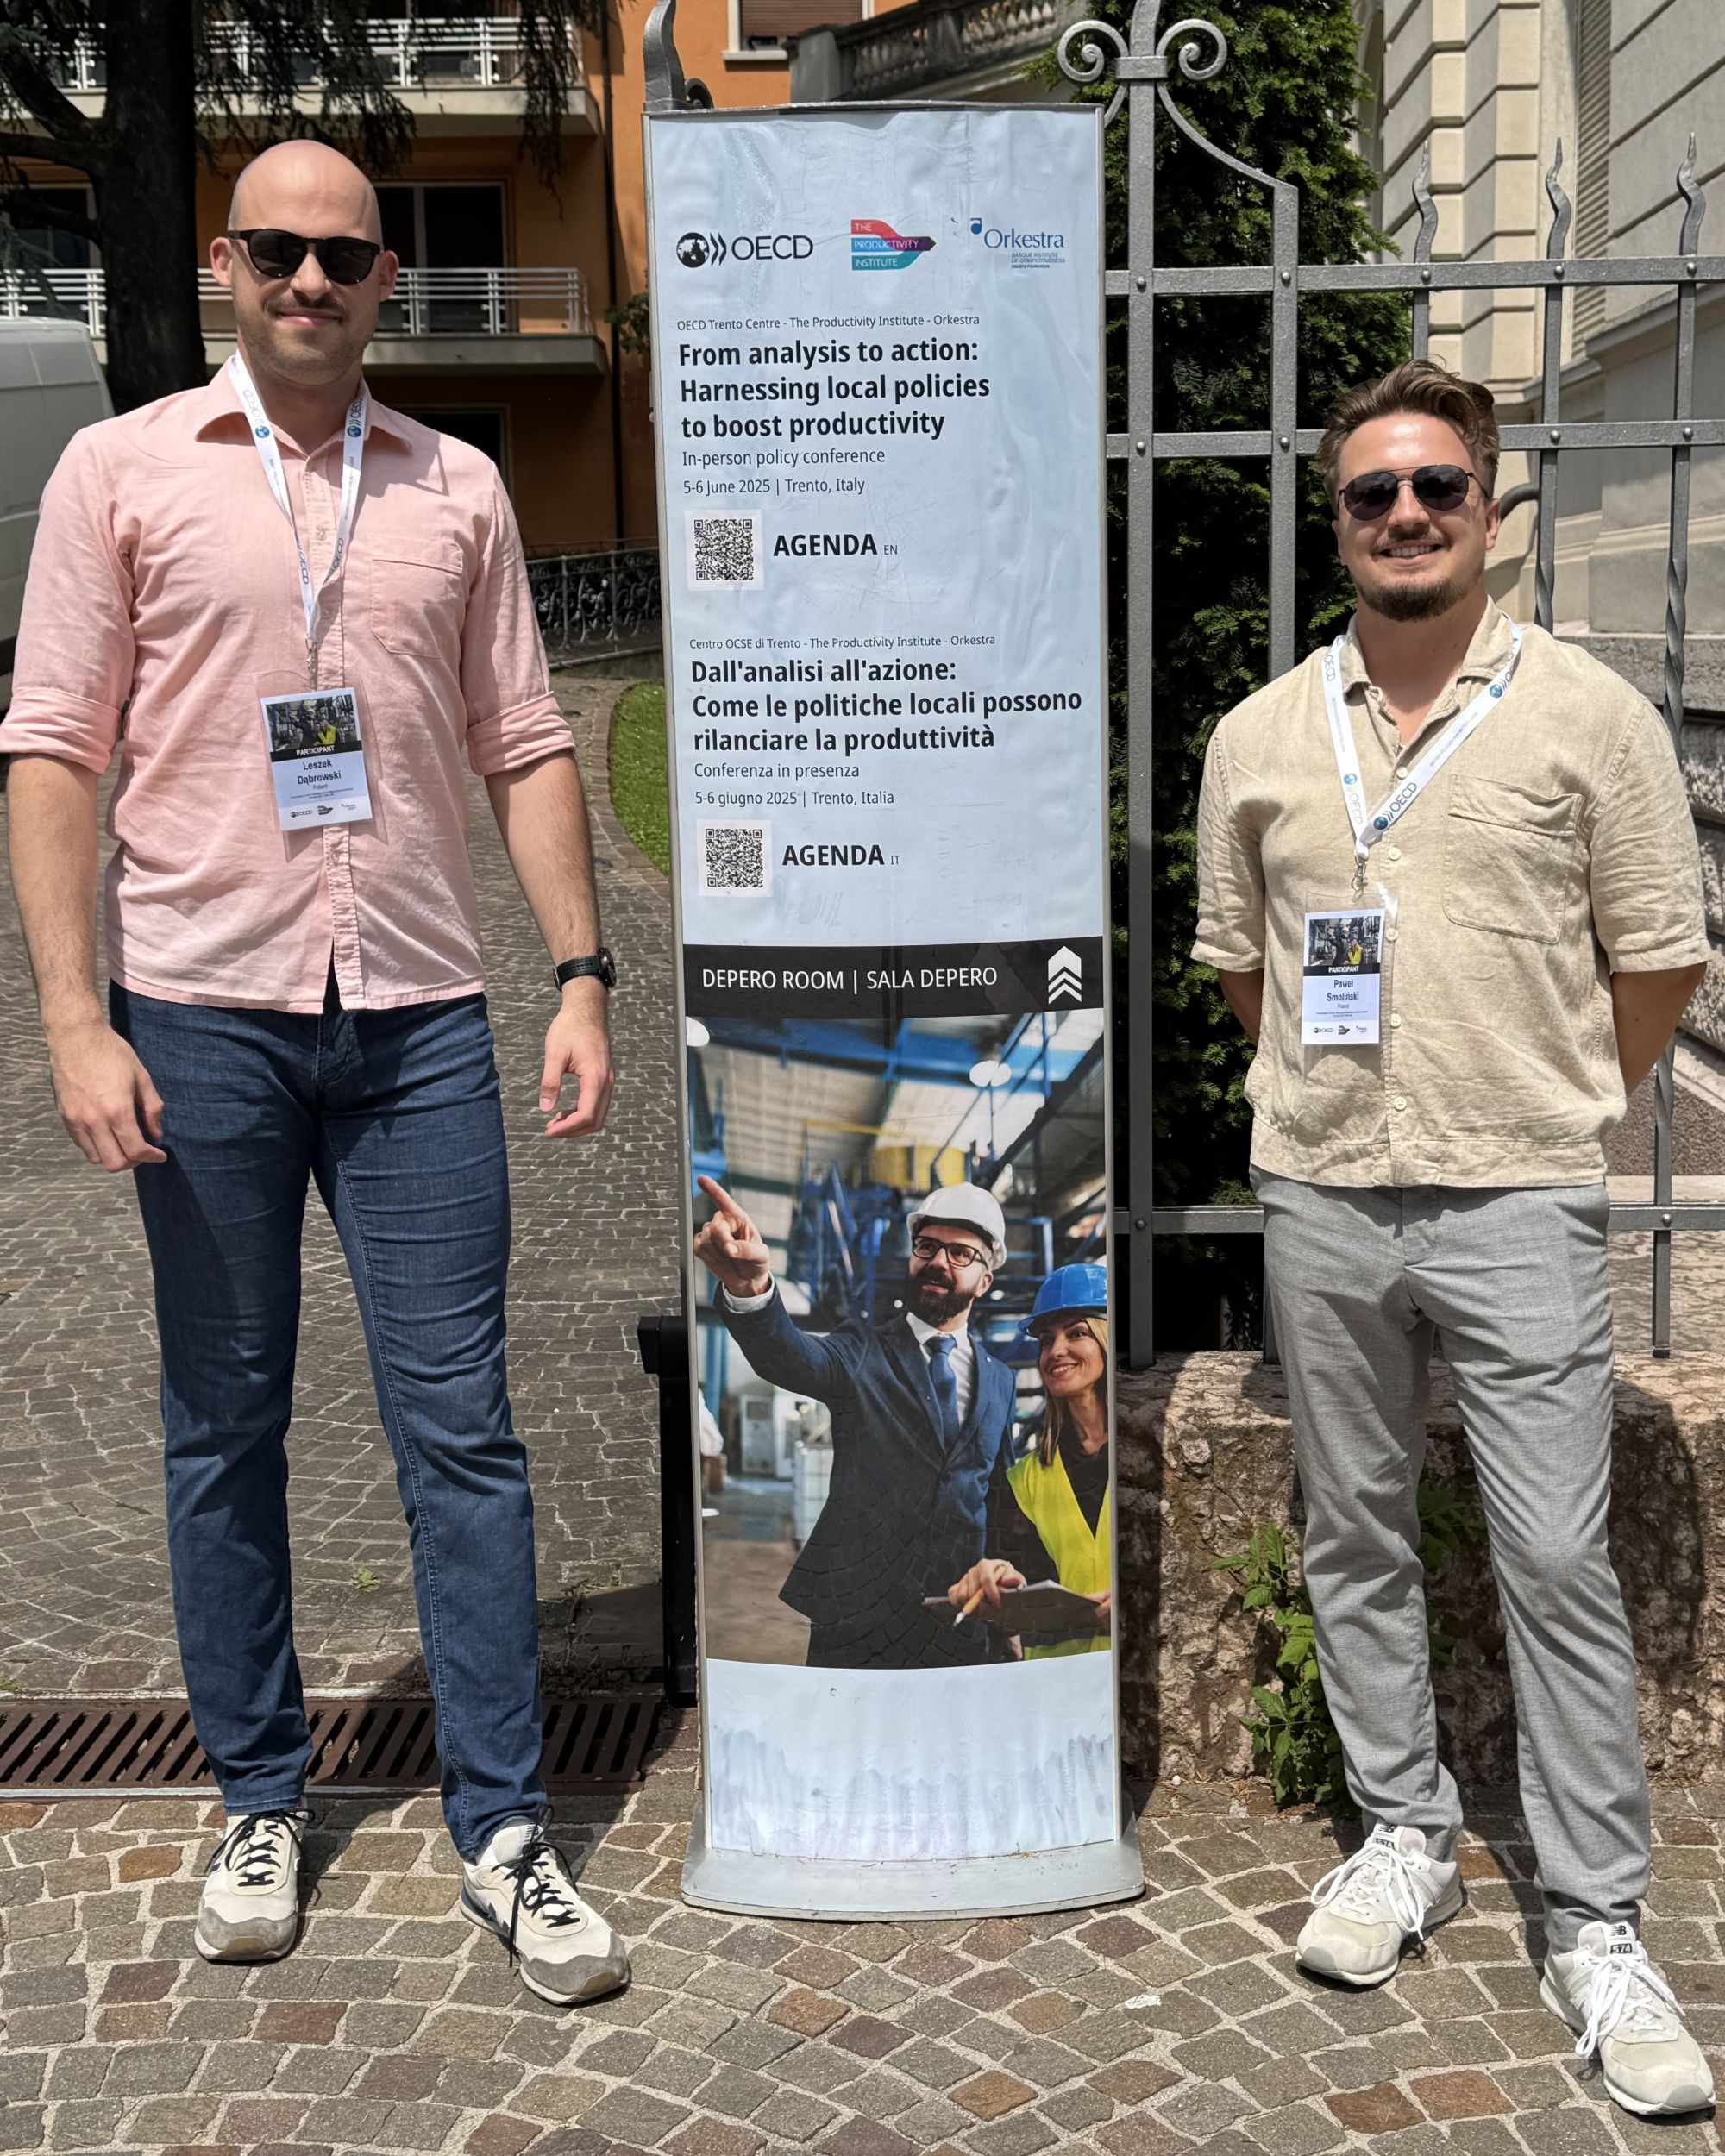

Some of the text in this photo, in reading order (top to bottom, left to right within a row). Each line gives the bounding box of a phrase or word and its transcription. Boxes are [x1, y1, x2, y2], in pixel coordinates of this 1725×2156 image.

[855, 222, 873, 232] THE
[731, 235, 813, 260] OECD
[854, 239, 919, 249] PRODUCTIVITY
[984, 228, 1063, 248] Orkestra
[855, 258, 898, 267] INSTITUTE
[678, 320, 706, 330] OECD
[709, 320, 742, 329] Trento
[746, 319, 780, 329] Centre
[789, 317, 809, 328] The
[813, 317, 875, 329] Productivity
[879, 316, 924, 326] Institute
[934, 315, 979, 325] Orkestra
[680, 337, 977, 370] From analysis to action:
[681, 373, 989, 406] Harnessing local policies
[681, 411, 944, 442] to boost productivity
[683, 448, 885, 469] In-person policy conference
[684, 480, 703, 493] 5-6
[706, 480, 735, 496] June
[739, 479, 770, 492] 2025
[785, 479, 831, 493] Trento,
[837, 477, 864, 494] Italy
[333, 537, 344, 568] OECD
[774, 534, 897, 556] AGENDA EN
[298, 551, 309, 585] OECD
[690, 639, 723, 649] Centro
[726, 639, 752, 649] OCSE
[756, 638, 764, 648] di
[767, 639, 800, 648] Trento
[810, 638, 829, 648] The
[832, 637, 894, 649] Productivity
[898, 636, 941, 646] Institute
[951, 636, 995, 645] Orkestra
[693, 658, 956, 682] Dall'analisi all'azione:
[1324, 655, 1336, 681] OECD
[693, 691, 1081, 723] Come le politiche locali possono
[694, 724, 994, 756] rilanciare la produttività
[296, 746, 335, 756] PARTICIPANT
[303, 759, 332, 770] Leszek
[695, 763, 859, 781] Conferenza in presenza
[298, 770, 342, 786] Dąbrowski
[696, 792, 714, 804] 5-6
[718, 792, 762, 807] giugno
[767, 792, 796, 804] 2025
[812, 792, 856, 805] Trento,
[862, 791, 894, 804] Italia
[1390, 782, 1417, 812] OECD
[1349, 793, 1363, 824] OECD
[782, 845, 900, 866] AGENDA IT
[703, 969, 776, 988] DEPERO
[783, 971, 843, 989] ROOM
[867, 970, 914, 988] SALA
[921, 968, 997, 987] DEPERO
[1611, 1944, 1631, 1953] 574
